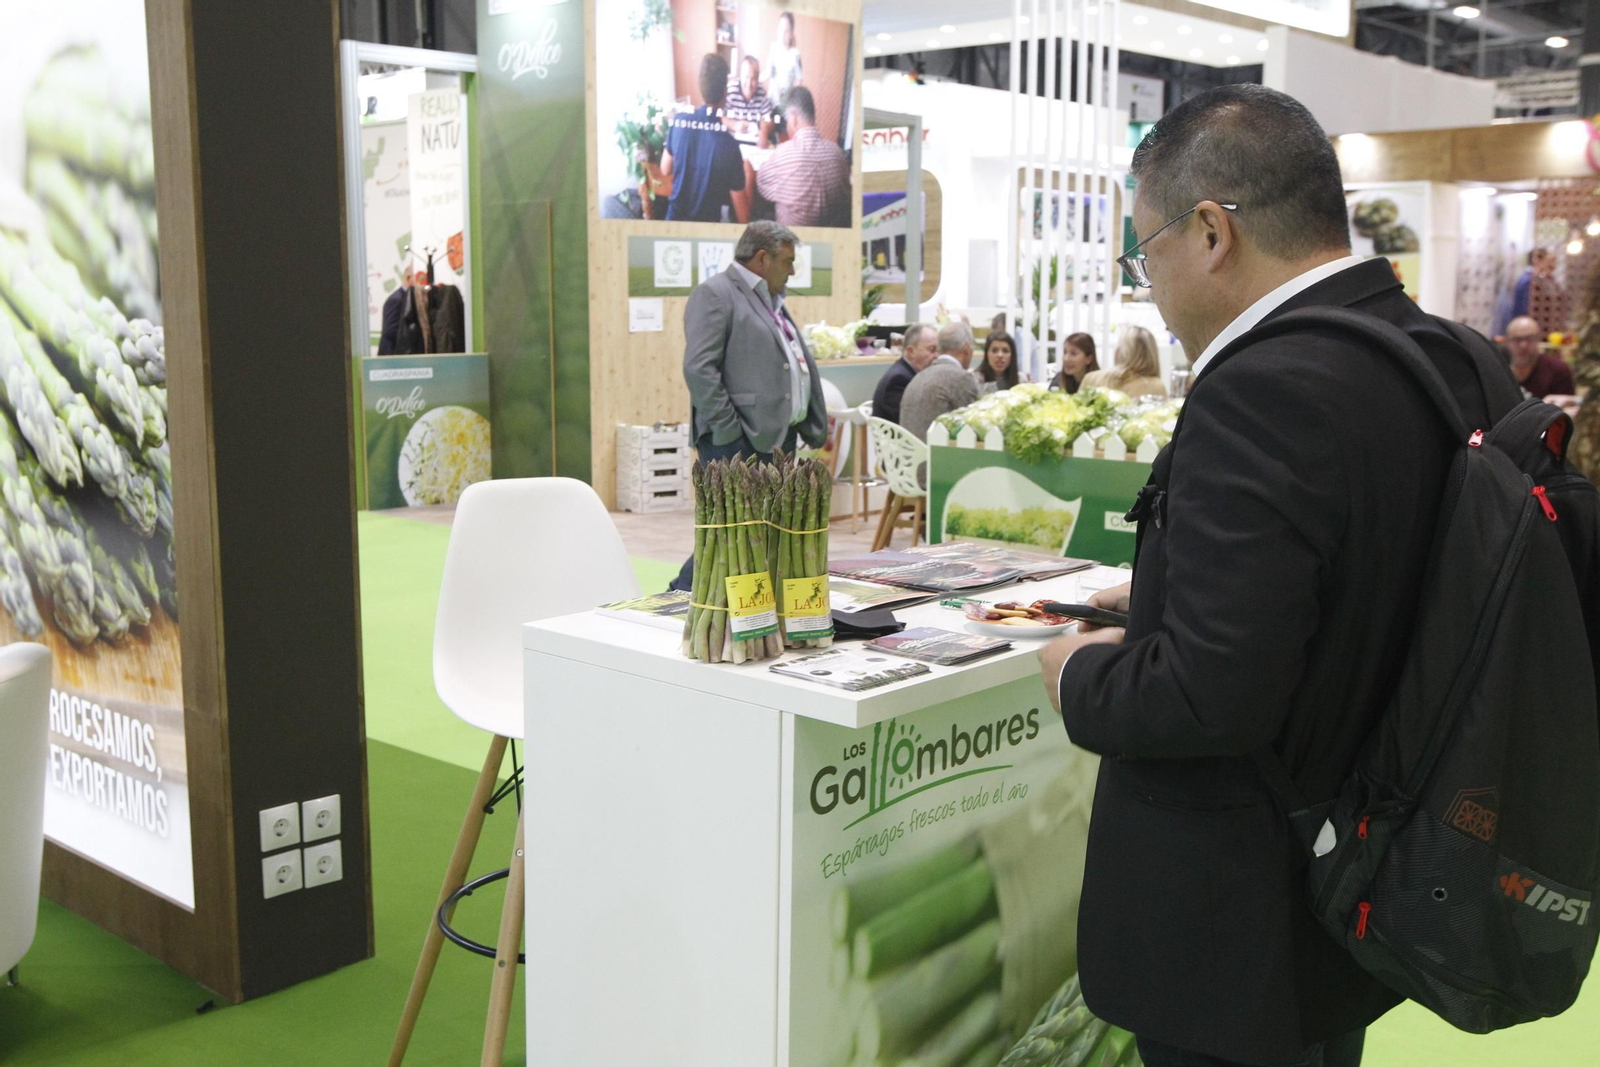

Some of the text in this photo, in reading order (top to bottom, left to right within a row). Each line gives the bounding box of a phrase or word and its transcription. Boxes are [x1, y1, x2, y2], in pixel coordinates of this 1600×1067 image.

[862, 127, 930, 145] sabr
[738, 594, 757, 610] LA
[794, 597, 812, 611] LA
[843, 741, 867, 761] LOS
[810, 708, 1040, 816] Gallombares
[50, 743, 169, 838] EXPORTAMOS
[821, 781, 1029, 879] Espárragos frescos todo el año
